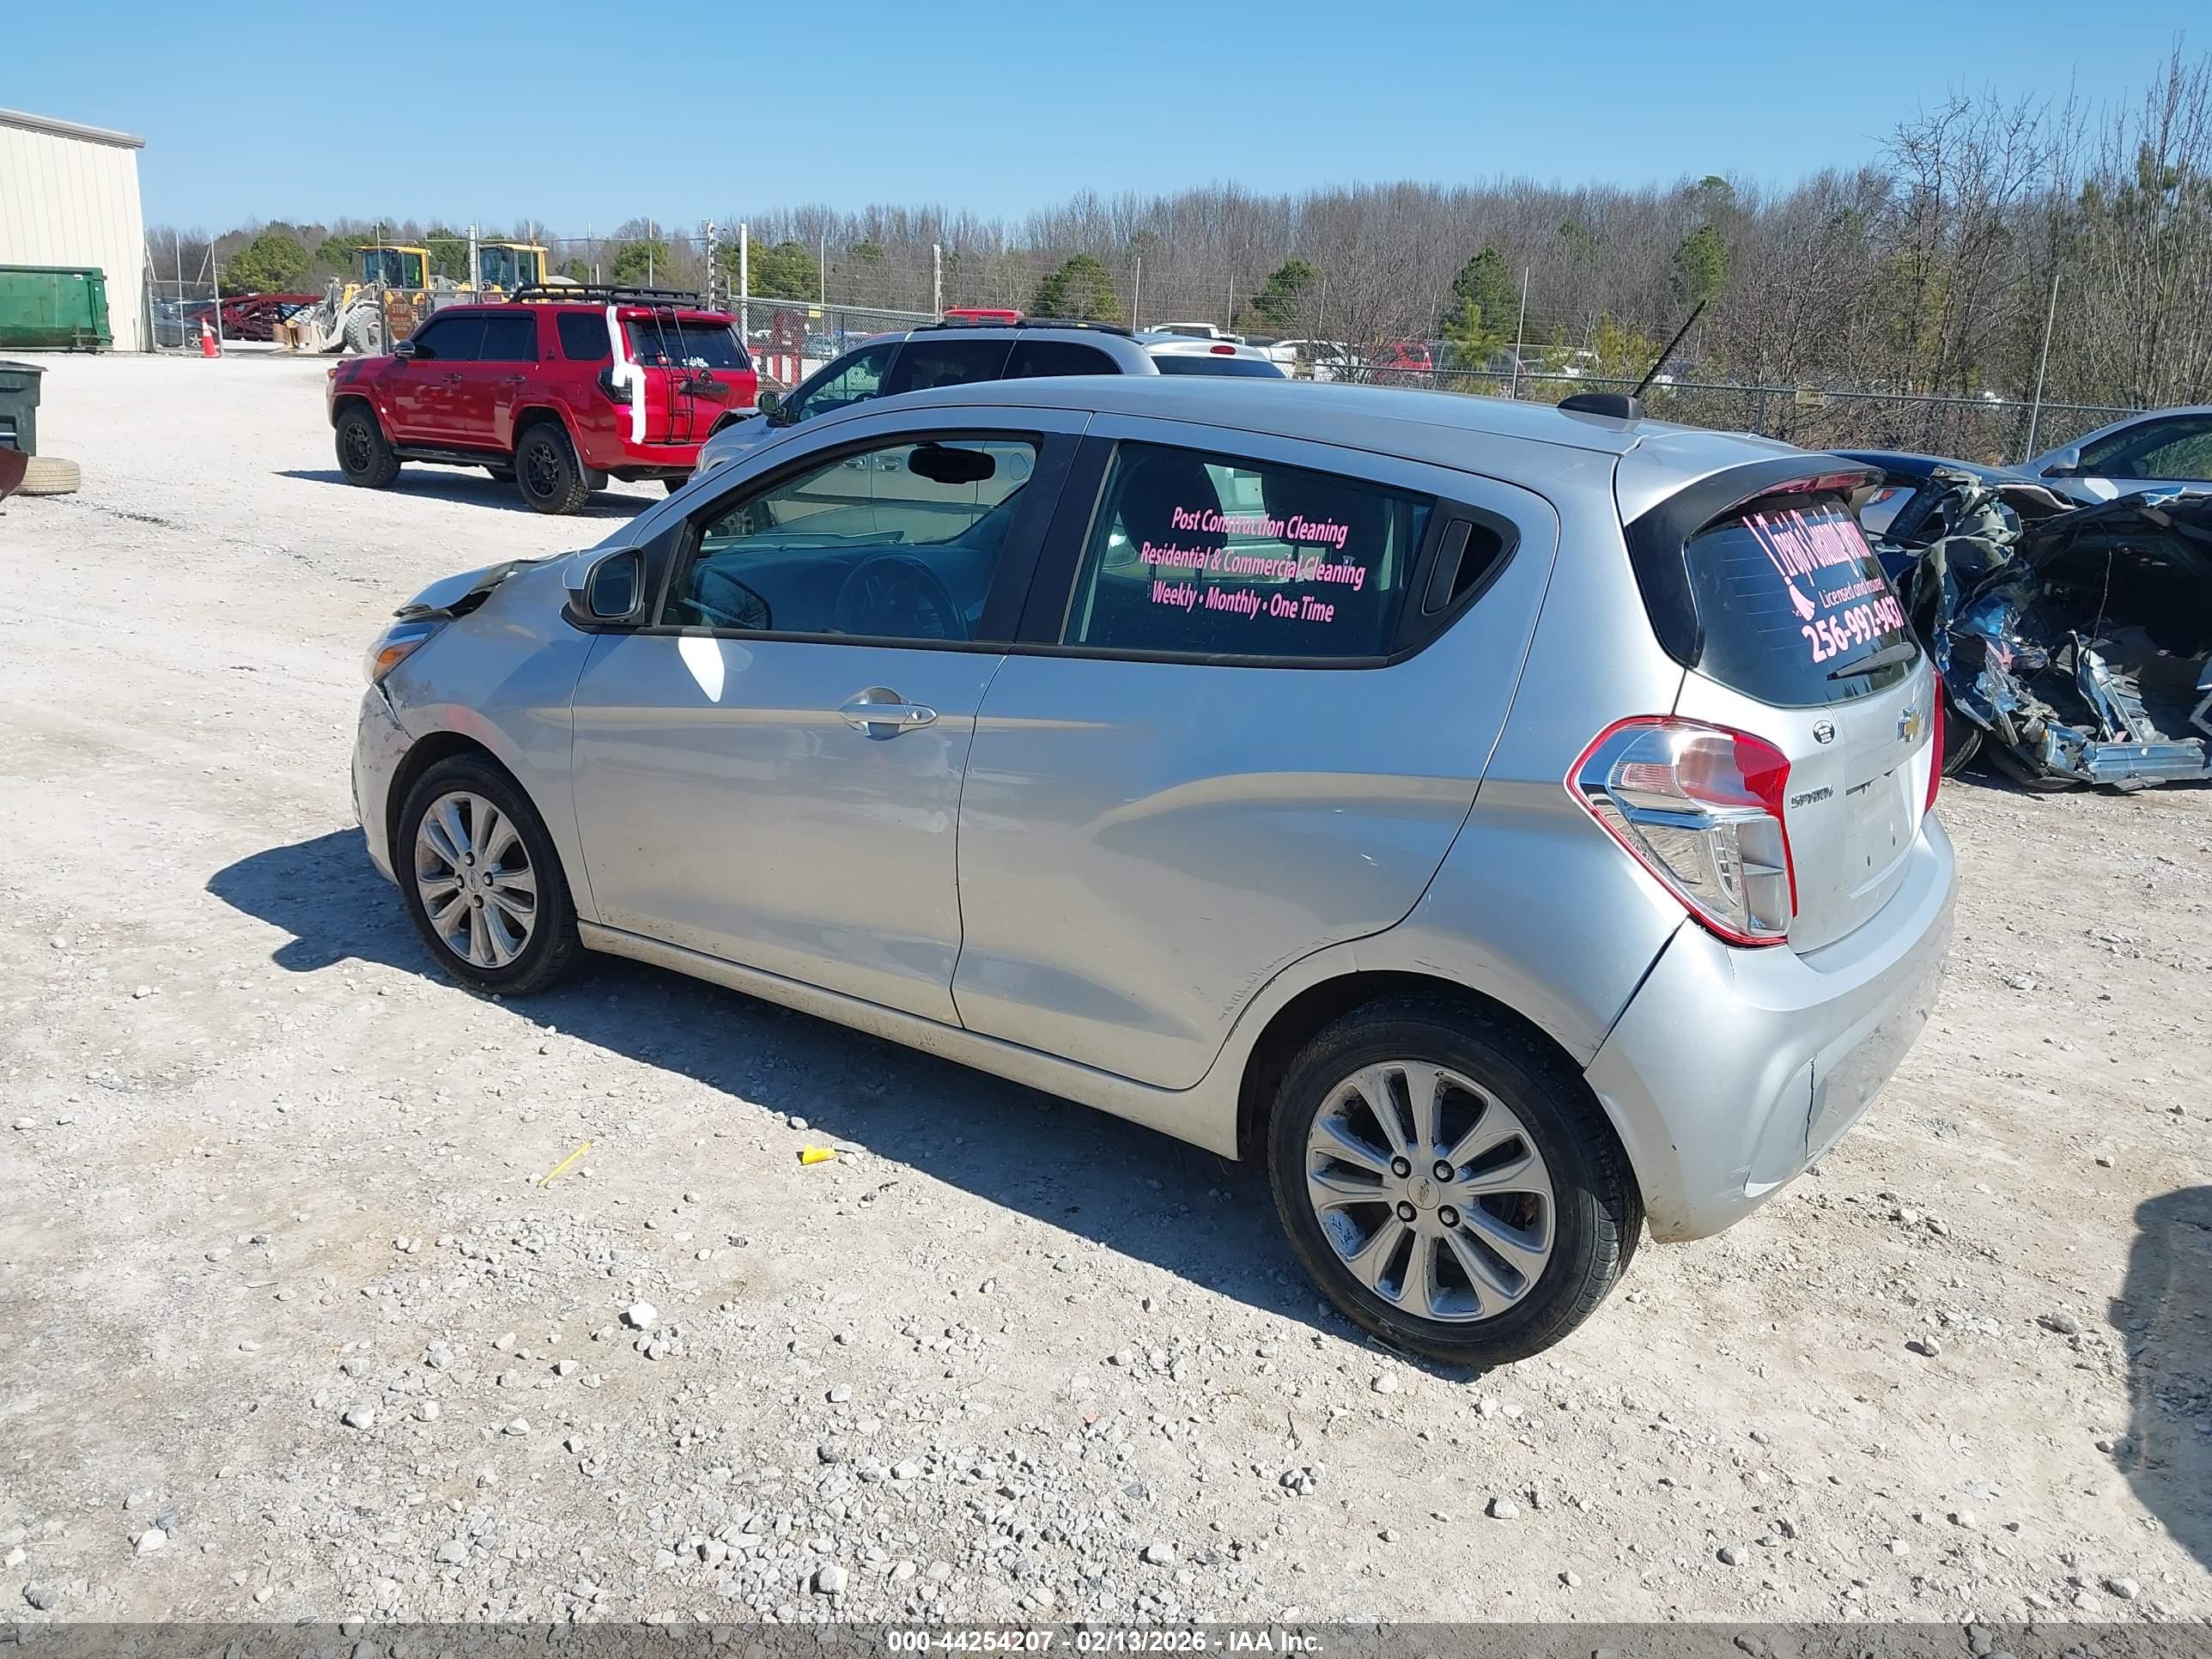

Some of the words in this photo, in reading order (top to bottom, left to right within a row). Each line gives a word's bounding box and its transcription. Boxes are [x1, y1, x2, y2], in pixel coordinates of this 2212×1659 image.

[392, 303, 408, 314] STOP
[1171, 506, 1200, 531] Post
[1201, 508, 1284, 538] Construction
[1287, 514, 1348, 549] Cleaning
[1140, 541, 1208, 569] Residential
[1210, 548, 1221, 570] &
[1223, 550, 1300, 581] Commercial
[1302, 556, 1366, 591] Cleaning
[1151, 580, 1198, 613] Weekly
[1205, 586, 1261, 621] Monthly
[1270, 593, 1297, 619] One
[1302, 596, 1334, 623] Time
[1818, 580, 1856, 609] Licensed
[1854, 577, 1869, 597] and
[1802, 595, 1905, 664] 256-992-9437
